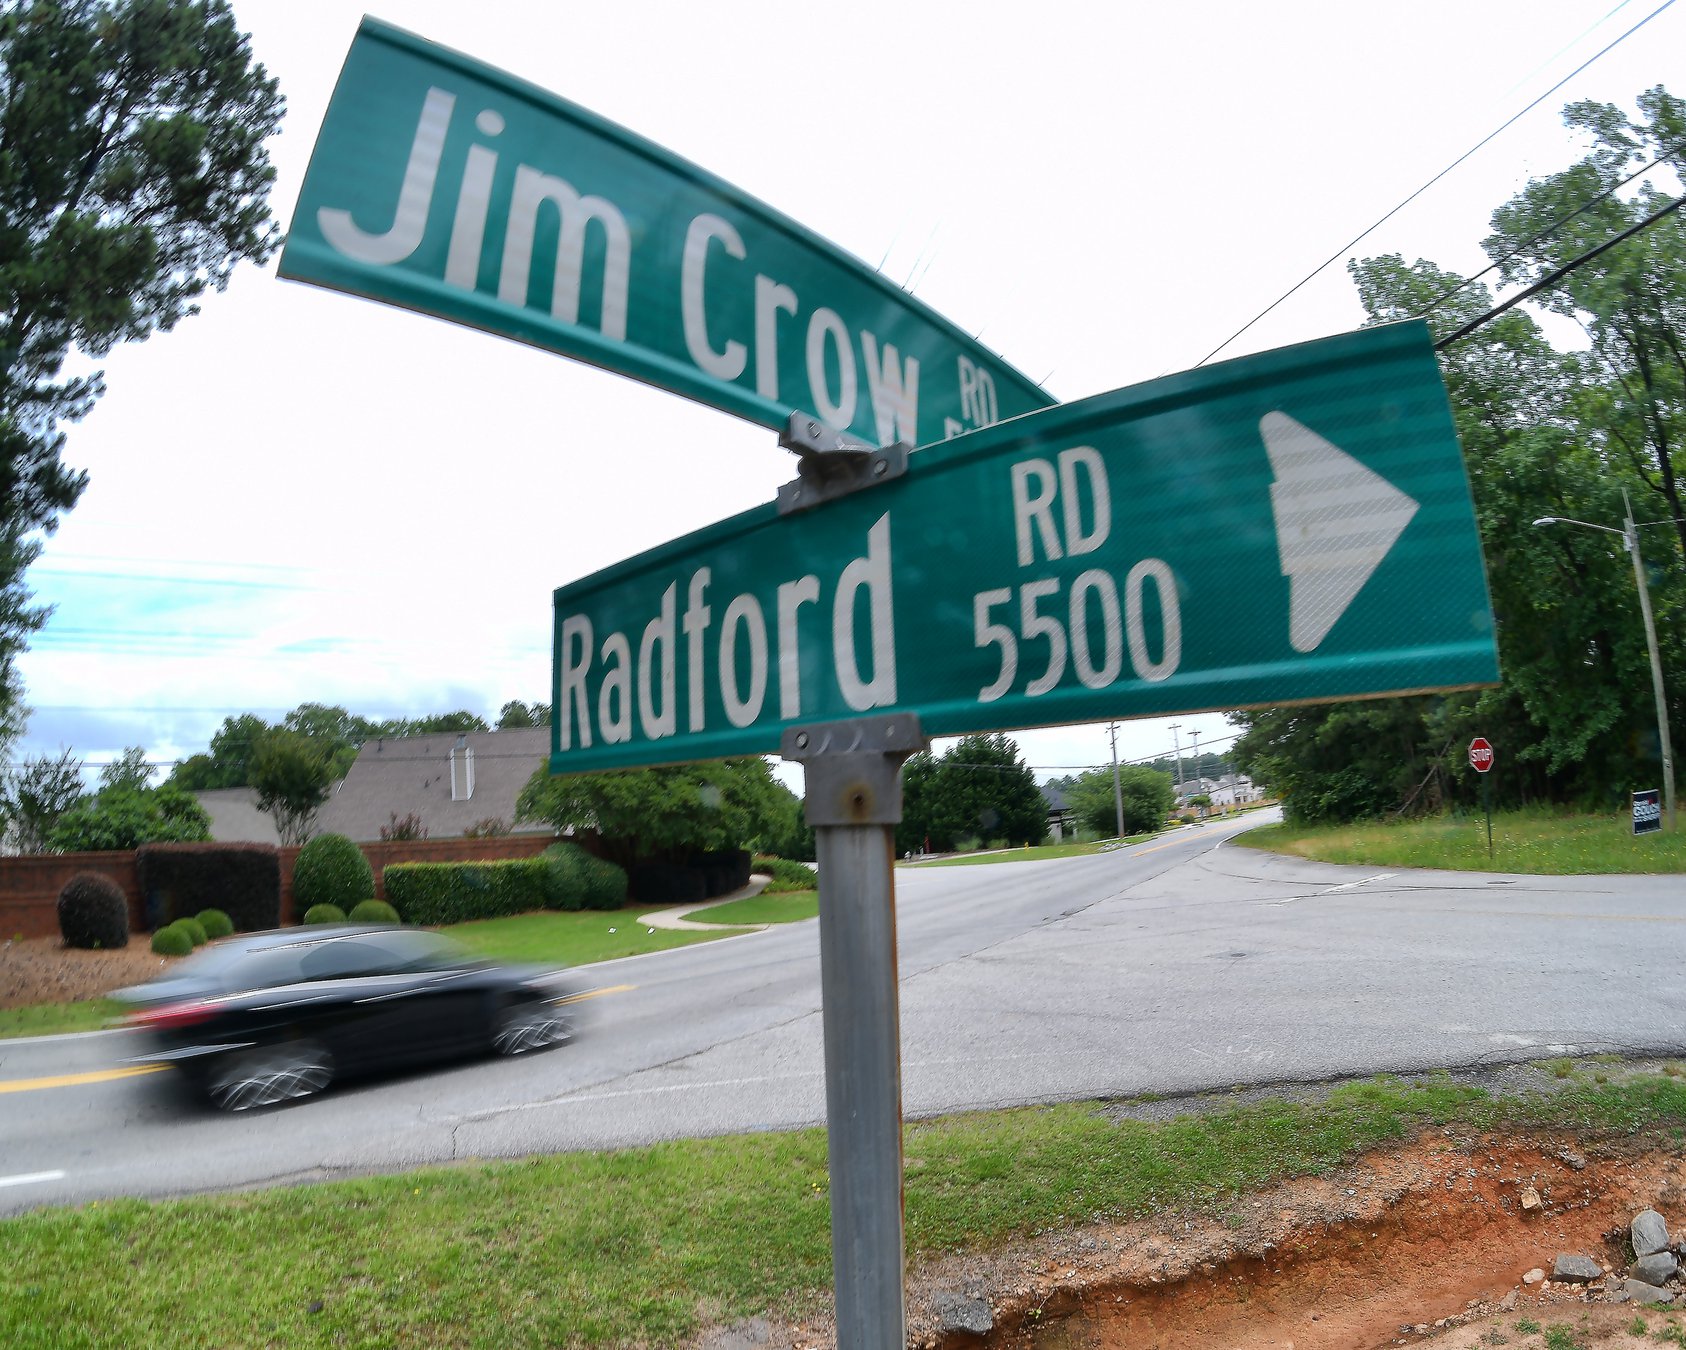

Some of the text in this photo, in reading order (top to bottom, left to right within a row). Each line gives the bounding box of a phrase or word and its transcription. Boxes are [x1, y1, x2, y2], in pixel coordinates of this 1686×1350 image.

[317, 85, 999, 448] Jim Crow RD
[558, 445, 1111, 753] Radford RD
[972, 557, 1183, 703] 5500
[1470, 748, 1492, 762] STOP
